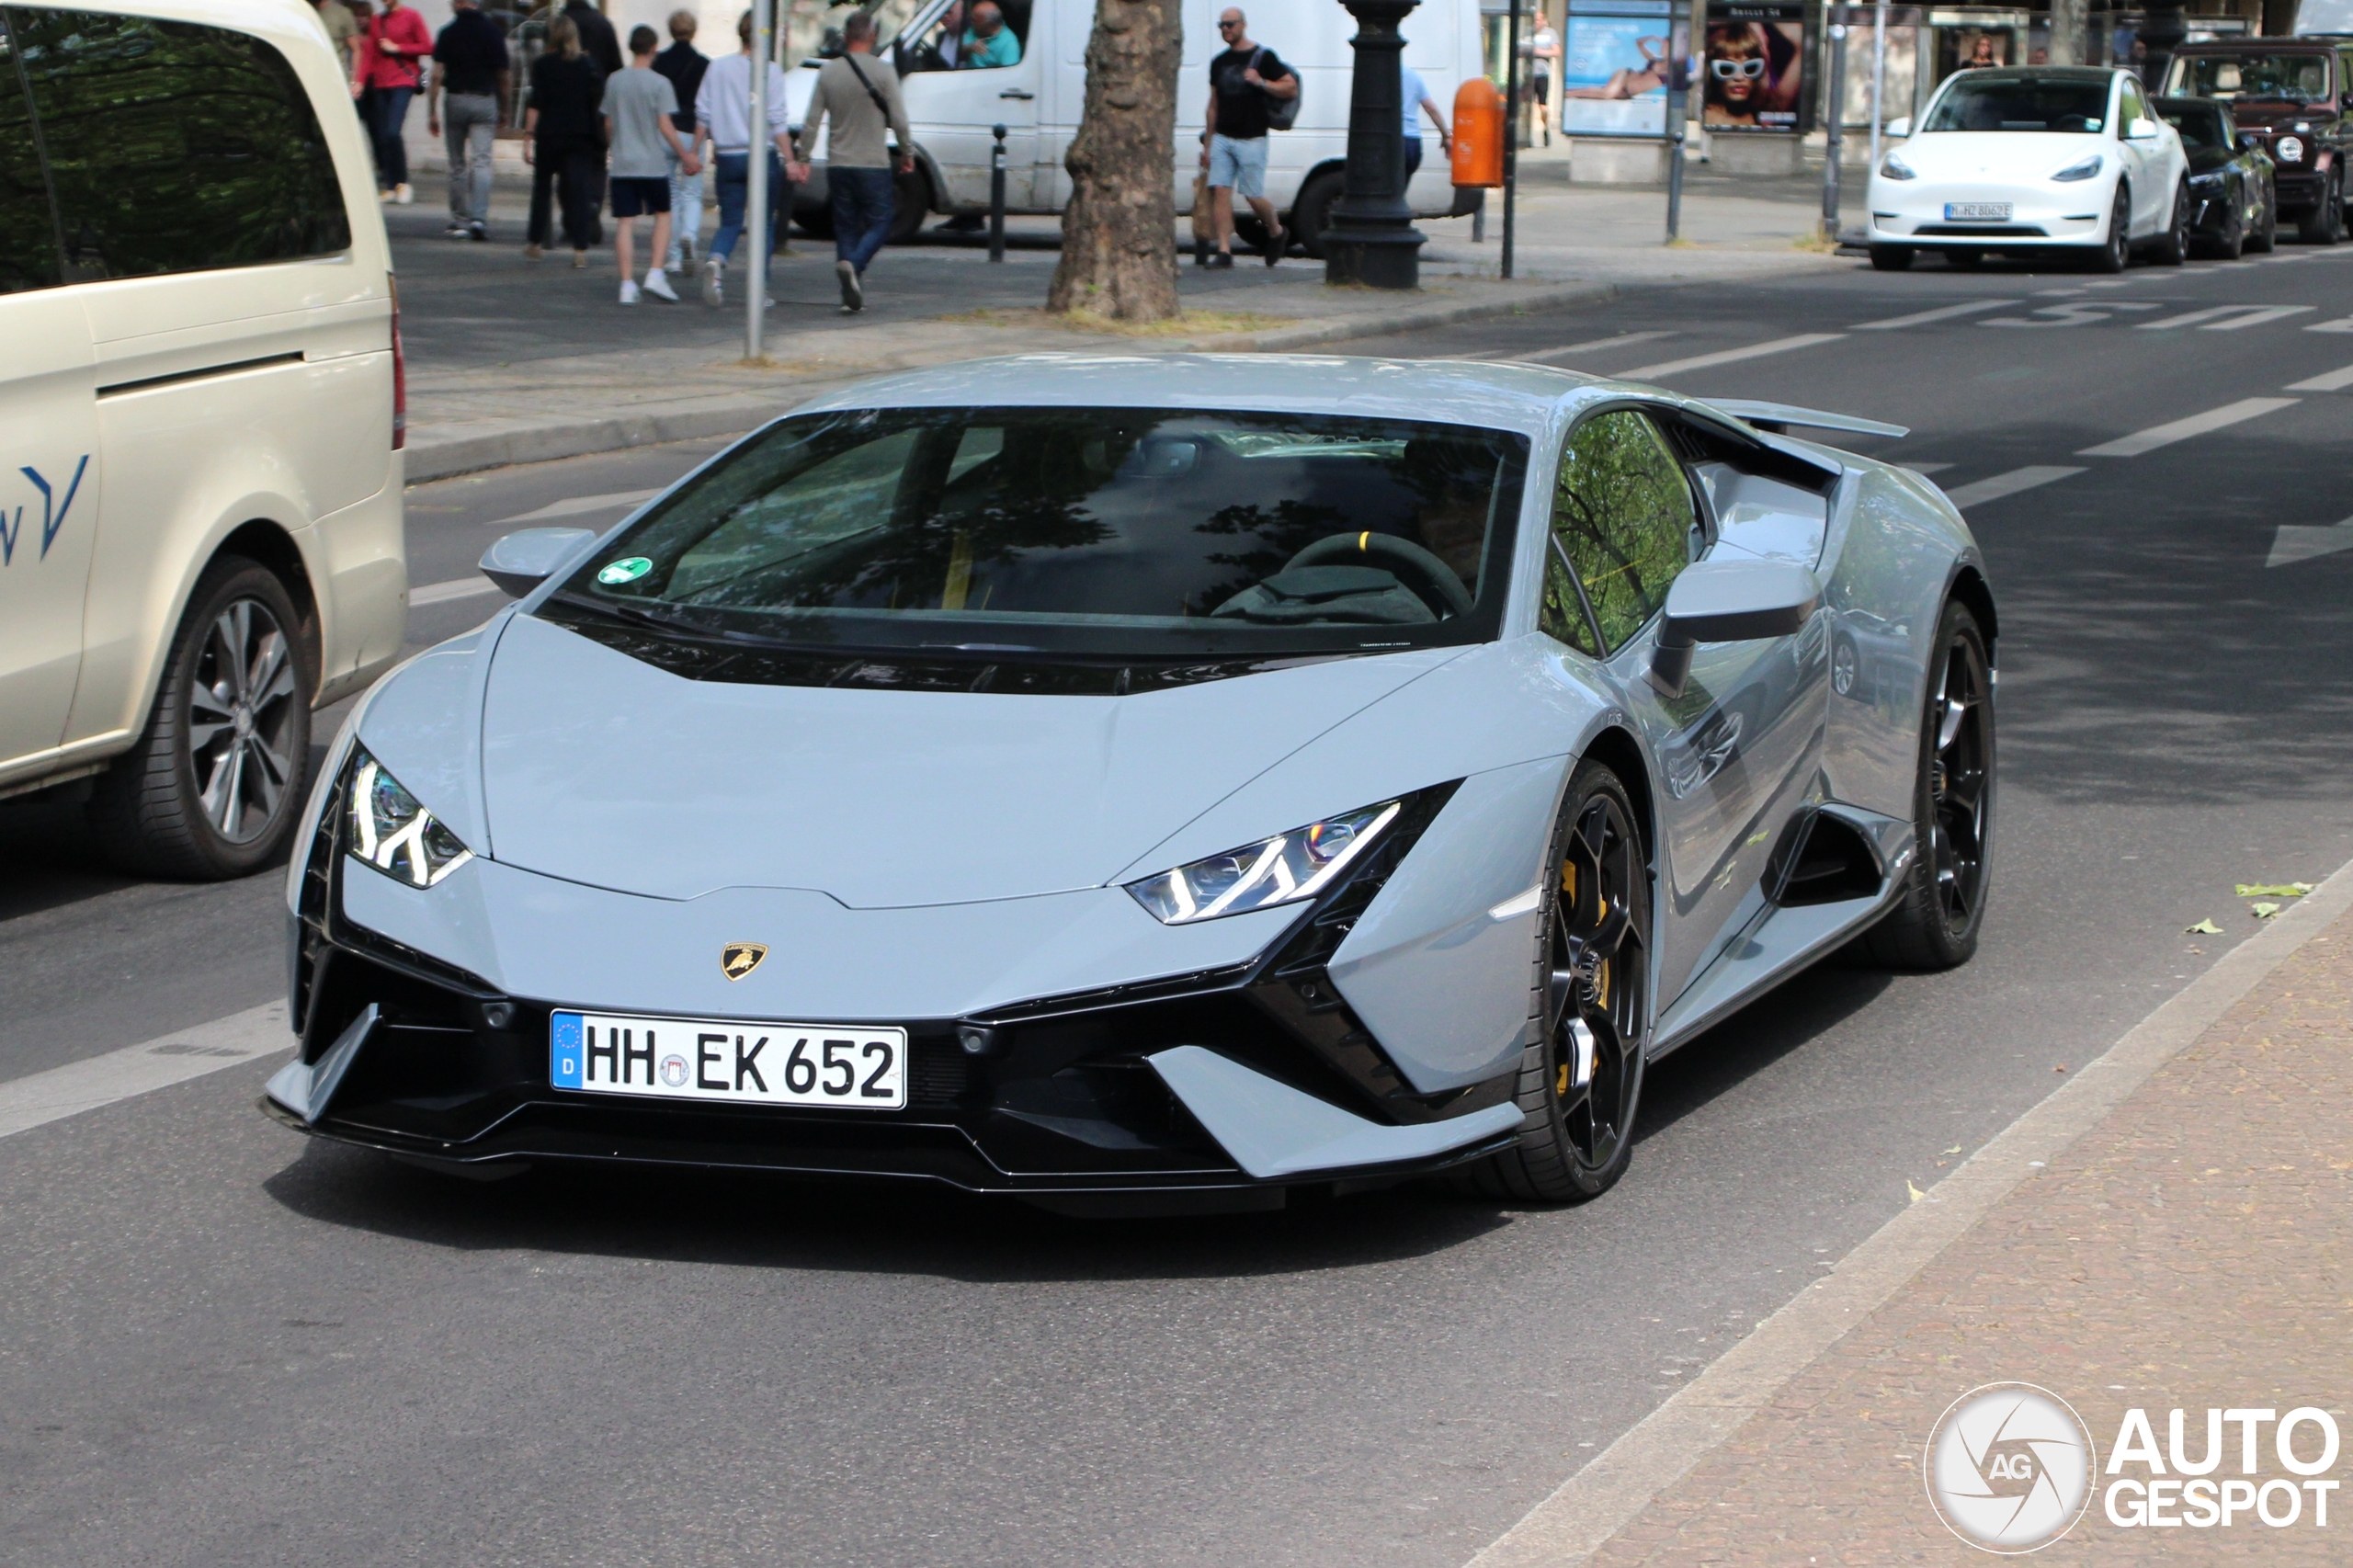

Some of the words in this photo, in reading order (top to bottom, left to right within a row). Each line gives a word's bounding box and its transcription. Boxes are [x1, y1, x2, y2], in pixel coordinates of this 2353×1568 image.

[563, 1058, 574, 1075] D
[586, 1025, 655, 1086] HH
[697, 1032, 769, 1093] EK
[785, 1038, 894, 1098] 652
